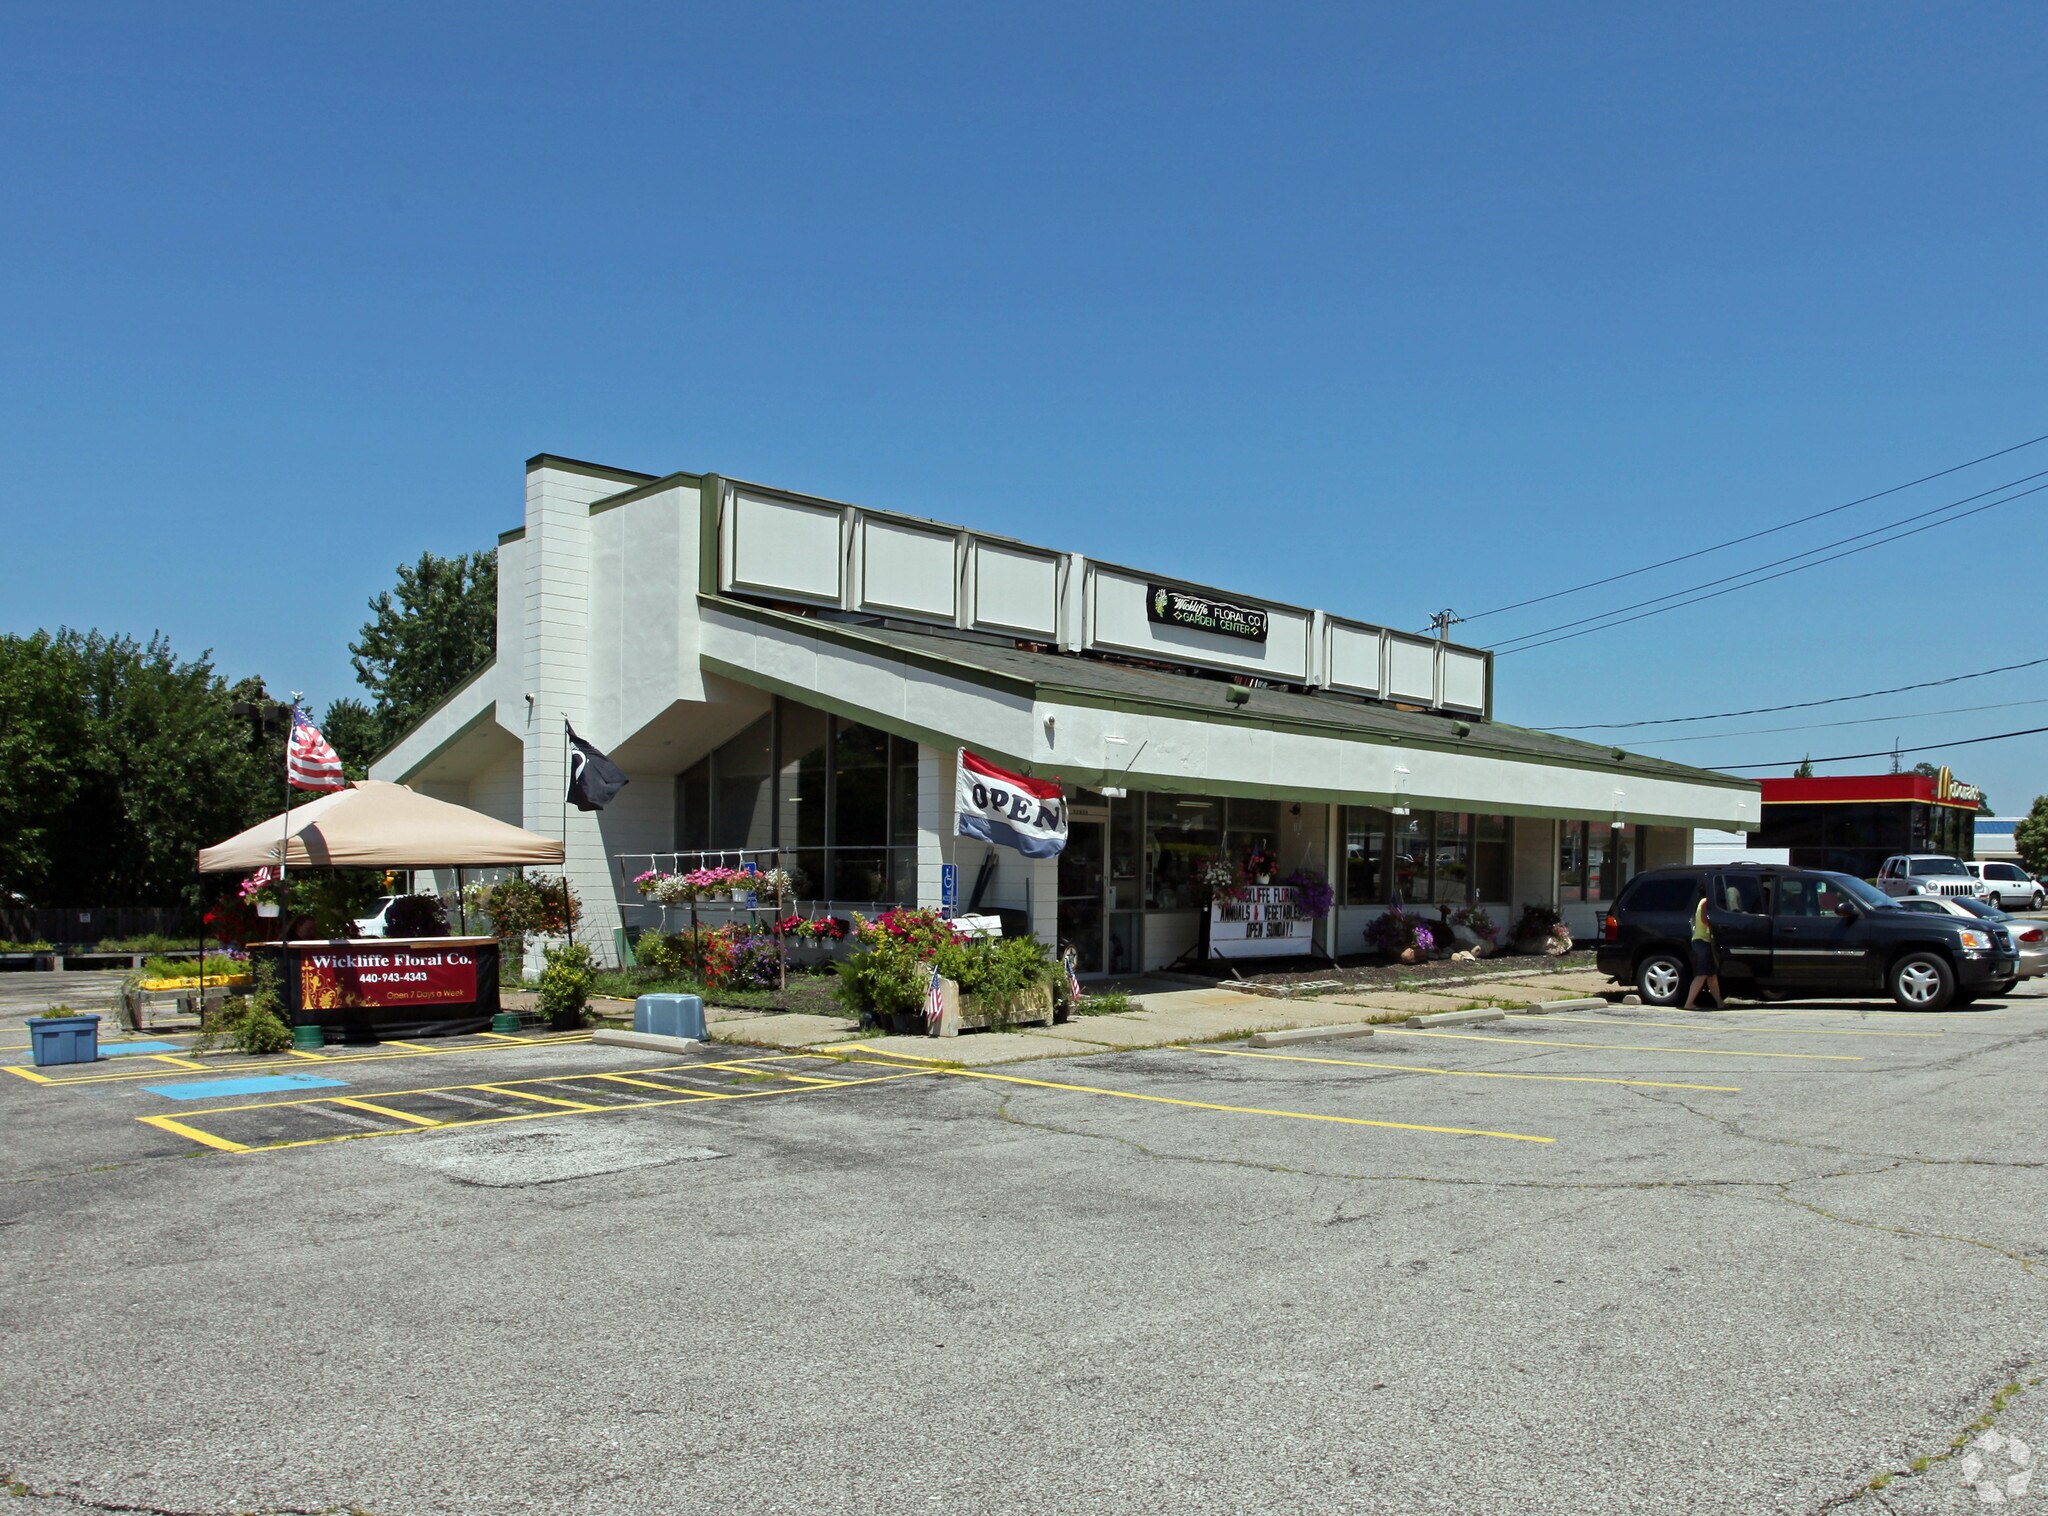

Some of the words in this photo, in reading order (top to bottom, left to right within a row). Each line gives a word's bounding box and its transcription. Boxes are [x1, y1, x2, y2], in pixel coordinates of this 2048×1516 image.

[1183, 612, 1216, 627] GARDEN
[1220, 620, 1250, 634] CENTER
[1214, 607, 1246, 624] FLORAL
[972, 783, 1060, 831] OPEN
[1220, 904, 1251, 921] ANNUALS
[1246, 922, 1263, 938] OPEN
[1266, 921, 1294, 938] SUNDAY!
[312, 954, 390, 969] Wickliffe
[394, 953, 442, 967] Floral
[446, 952, 472, 966] Co.
[359, 972, 428, 983] 440-943-4343
[387, 991, 409, 1000] Open
[410, 990, 415, 998] 7
[416, 990, 436, 1000] Days
[443, 989, 464, 997] Week
